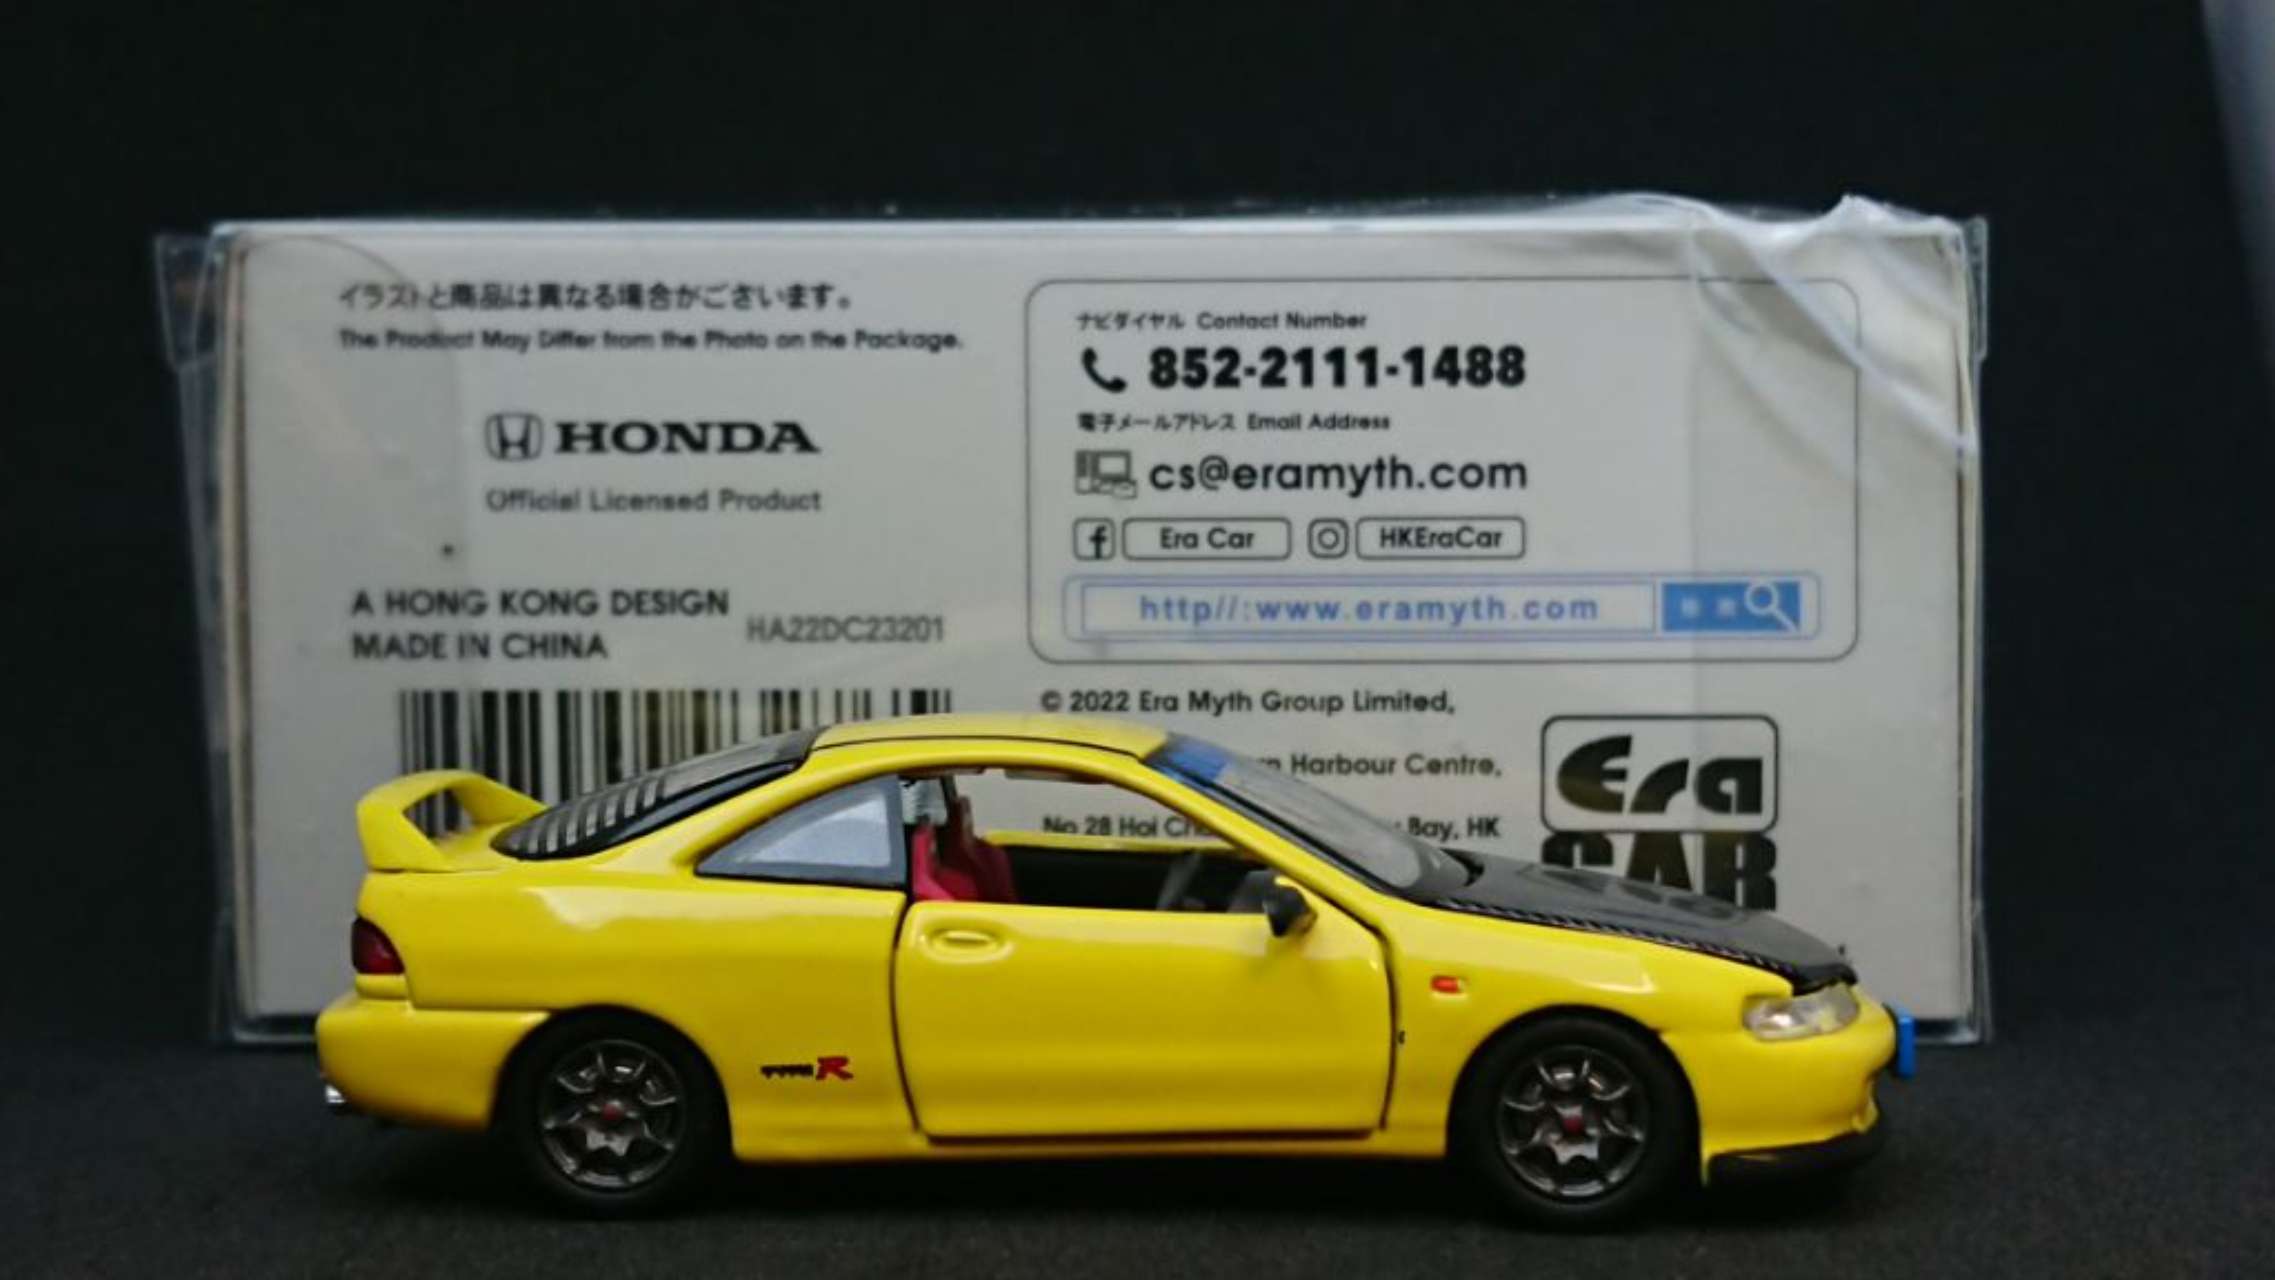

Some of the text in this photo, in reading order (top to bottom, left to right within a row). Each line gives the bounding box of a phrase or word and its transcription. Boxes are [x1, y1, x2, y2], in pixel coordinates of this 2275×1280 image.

[1076, 311, 1185, 331] ナビダイヤル
[1196, 311, 1368, 330] Contact Number
[338, 329, 964, 354] The Product May Differ from the Photo on the Package.
[1148, 345, 1527, 389] 852-2111-1488
[1077, 411, 1236, 433] 電子メールアドレス
[1247, 412, 1391, 432] Email Address
[555, 420, 821, 455] HONDA
[1148, 454, 1528, 498] cs@eramyth.com
[485, 488, 822, 513] Official Licensed Product
[1159, 525, 1256, 550] Era Car
[1379, 525, 1503, 550] HKEraCar
[350, 588, 730, 618] A HONG KONG DESIGN
[745, 614, 945, 644] HA22DC23201
[351, 632, 608, 660] MADE IN CHINA
[1069, 689, 1130, 713] 2022
[1138, 689, 1179, 713] Era
[1187, 689, 1253, 717] Myth
[1260, 689, 1345, 717] Group
[1353, 689, 1456, 716] Limited,
[1290, 753, 1397, 776] Harbour
[1403, 753, 1502, 779] Centre,
[1557, 735, 1762, 814] Era
[1043, 816, 1078, 834] No
[1085, 816, 1112, 836] 28
[1118, 816, 1158, 836] Hoi
[1406, 816, 1502, 842] Bay, HK
[815, 1055, 855, 1081] R
